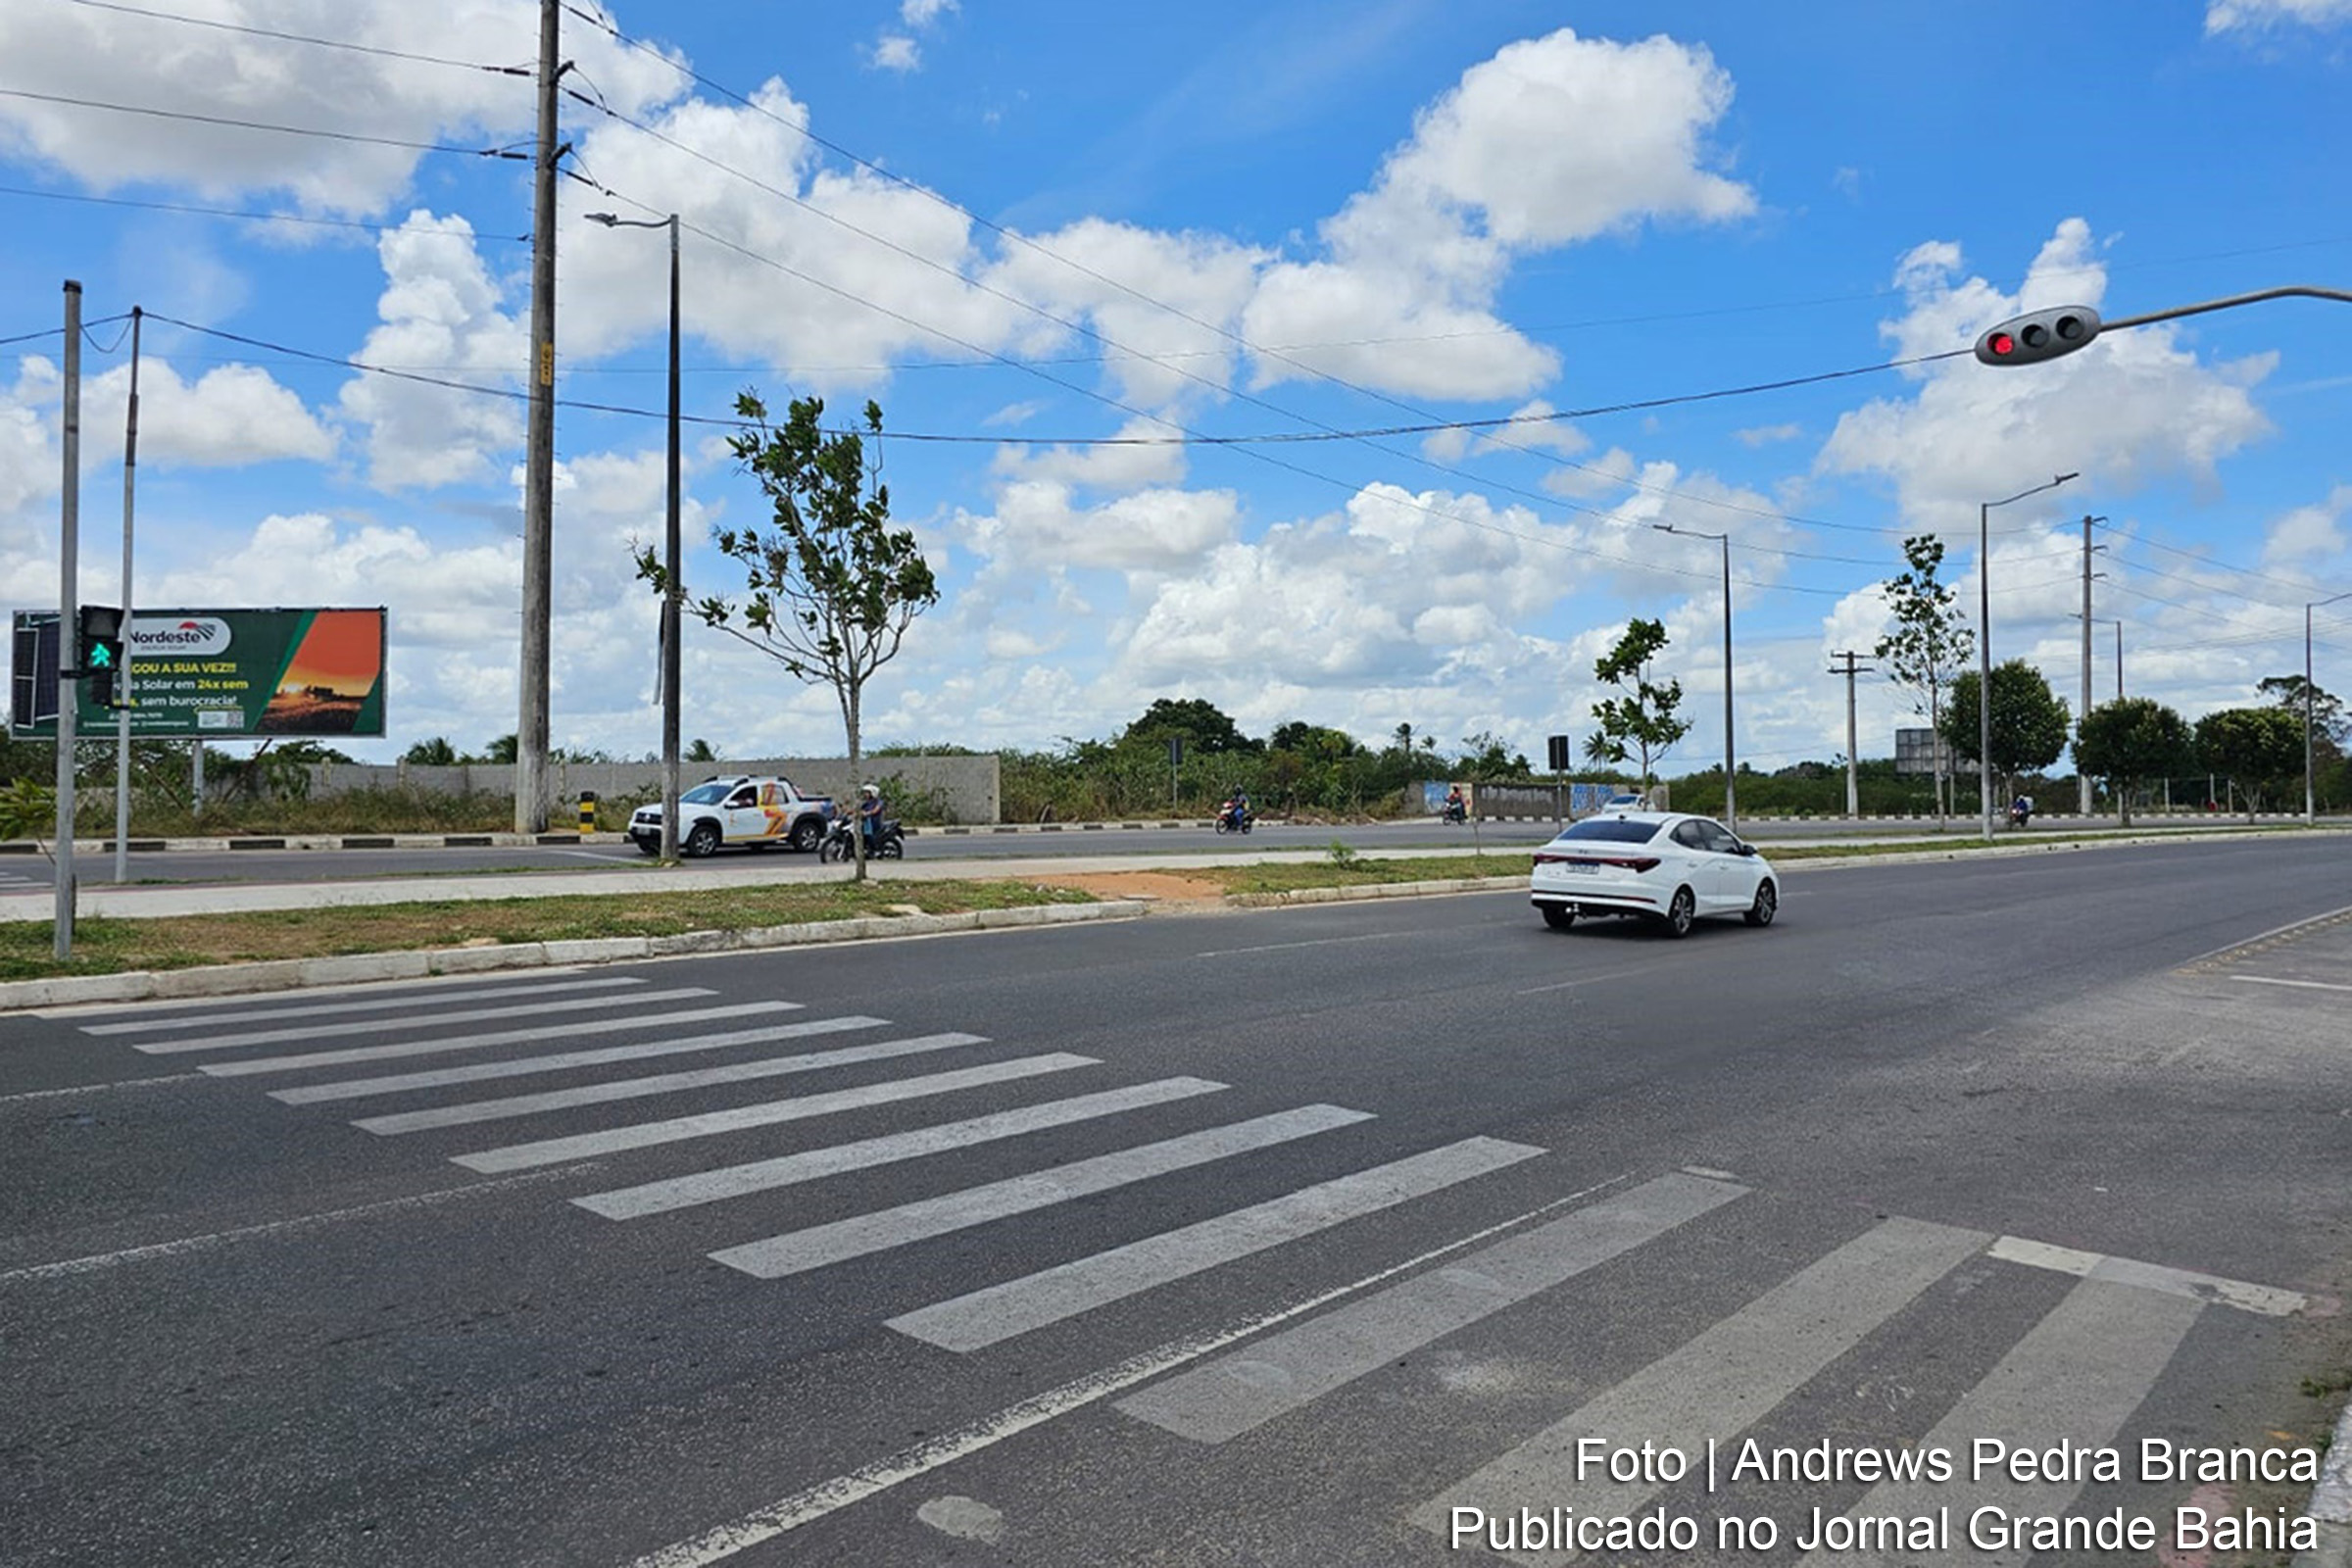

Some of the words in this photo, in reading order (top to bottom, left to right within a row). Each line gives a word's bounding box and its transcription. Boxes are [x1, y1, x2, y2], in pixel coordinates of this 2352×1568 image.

[130, 630, 201, 644] Nordeste
[162, 662, 171, 673] A
[172, 662, 199, 673] SUA
[141, 679, 173, 690] Solar
[174, 681, 196, 690] em
[197, 678, 220, 690] 24x
[221, 681, 249, 690] sem
[141, 697, 168, 707] sem
[169, 695, 237, 707] burocracia!
